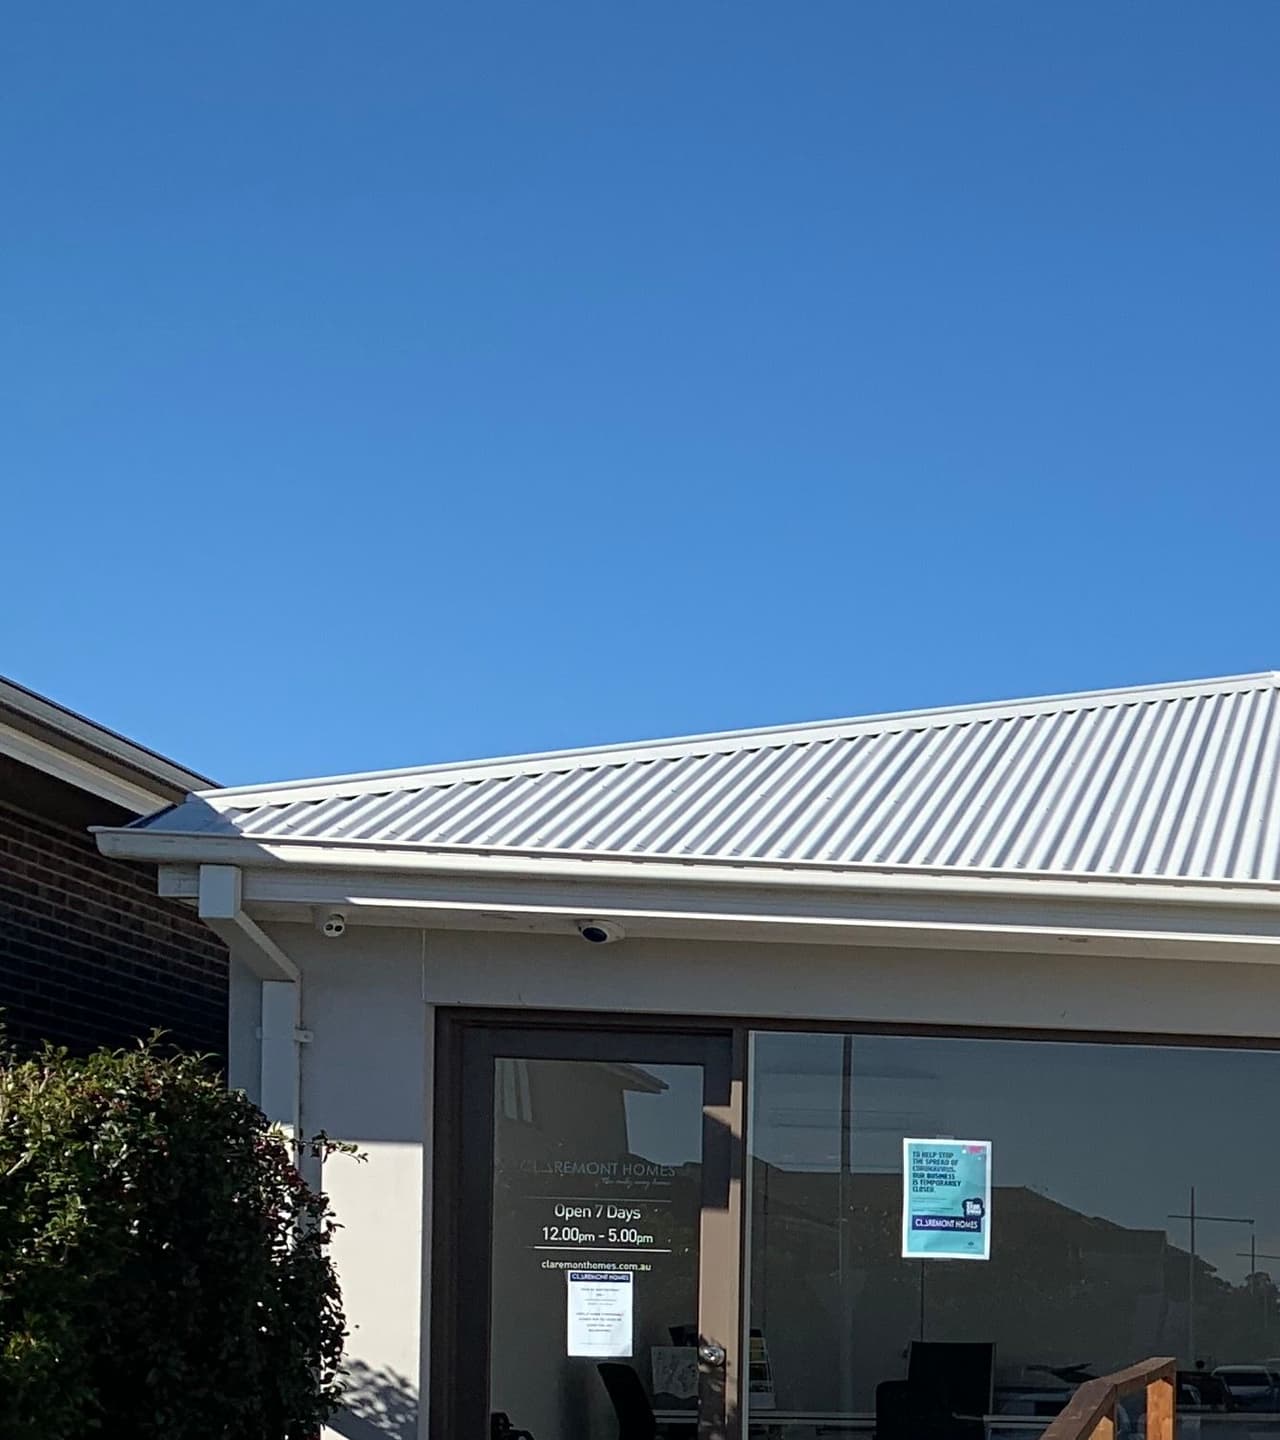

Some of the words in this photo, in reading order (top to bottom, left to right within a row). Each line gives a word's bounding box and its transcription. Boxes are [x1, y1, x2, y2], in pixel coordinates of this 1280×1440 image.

[520, 1160, 619, 1176] CLAREMONT
[622, 1161, 676, 1178] HOMES
[554, 1203, 592, 1221] Open
[595, 1205, 604, 1219] 7
[607, 1205, 642, 1222] Days
[955, 1219, 978, 1229] HOMES
[542, 1226, 596, 1244] 12.00pm
[608, 1228, 654, 1246] 5.00pm
[541, 1259, 652, 1272] claremonthomes.com.au
